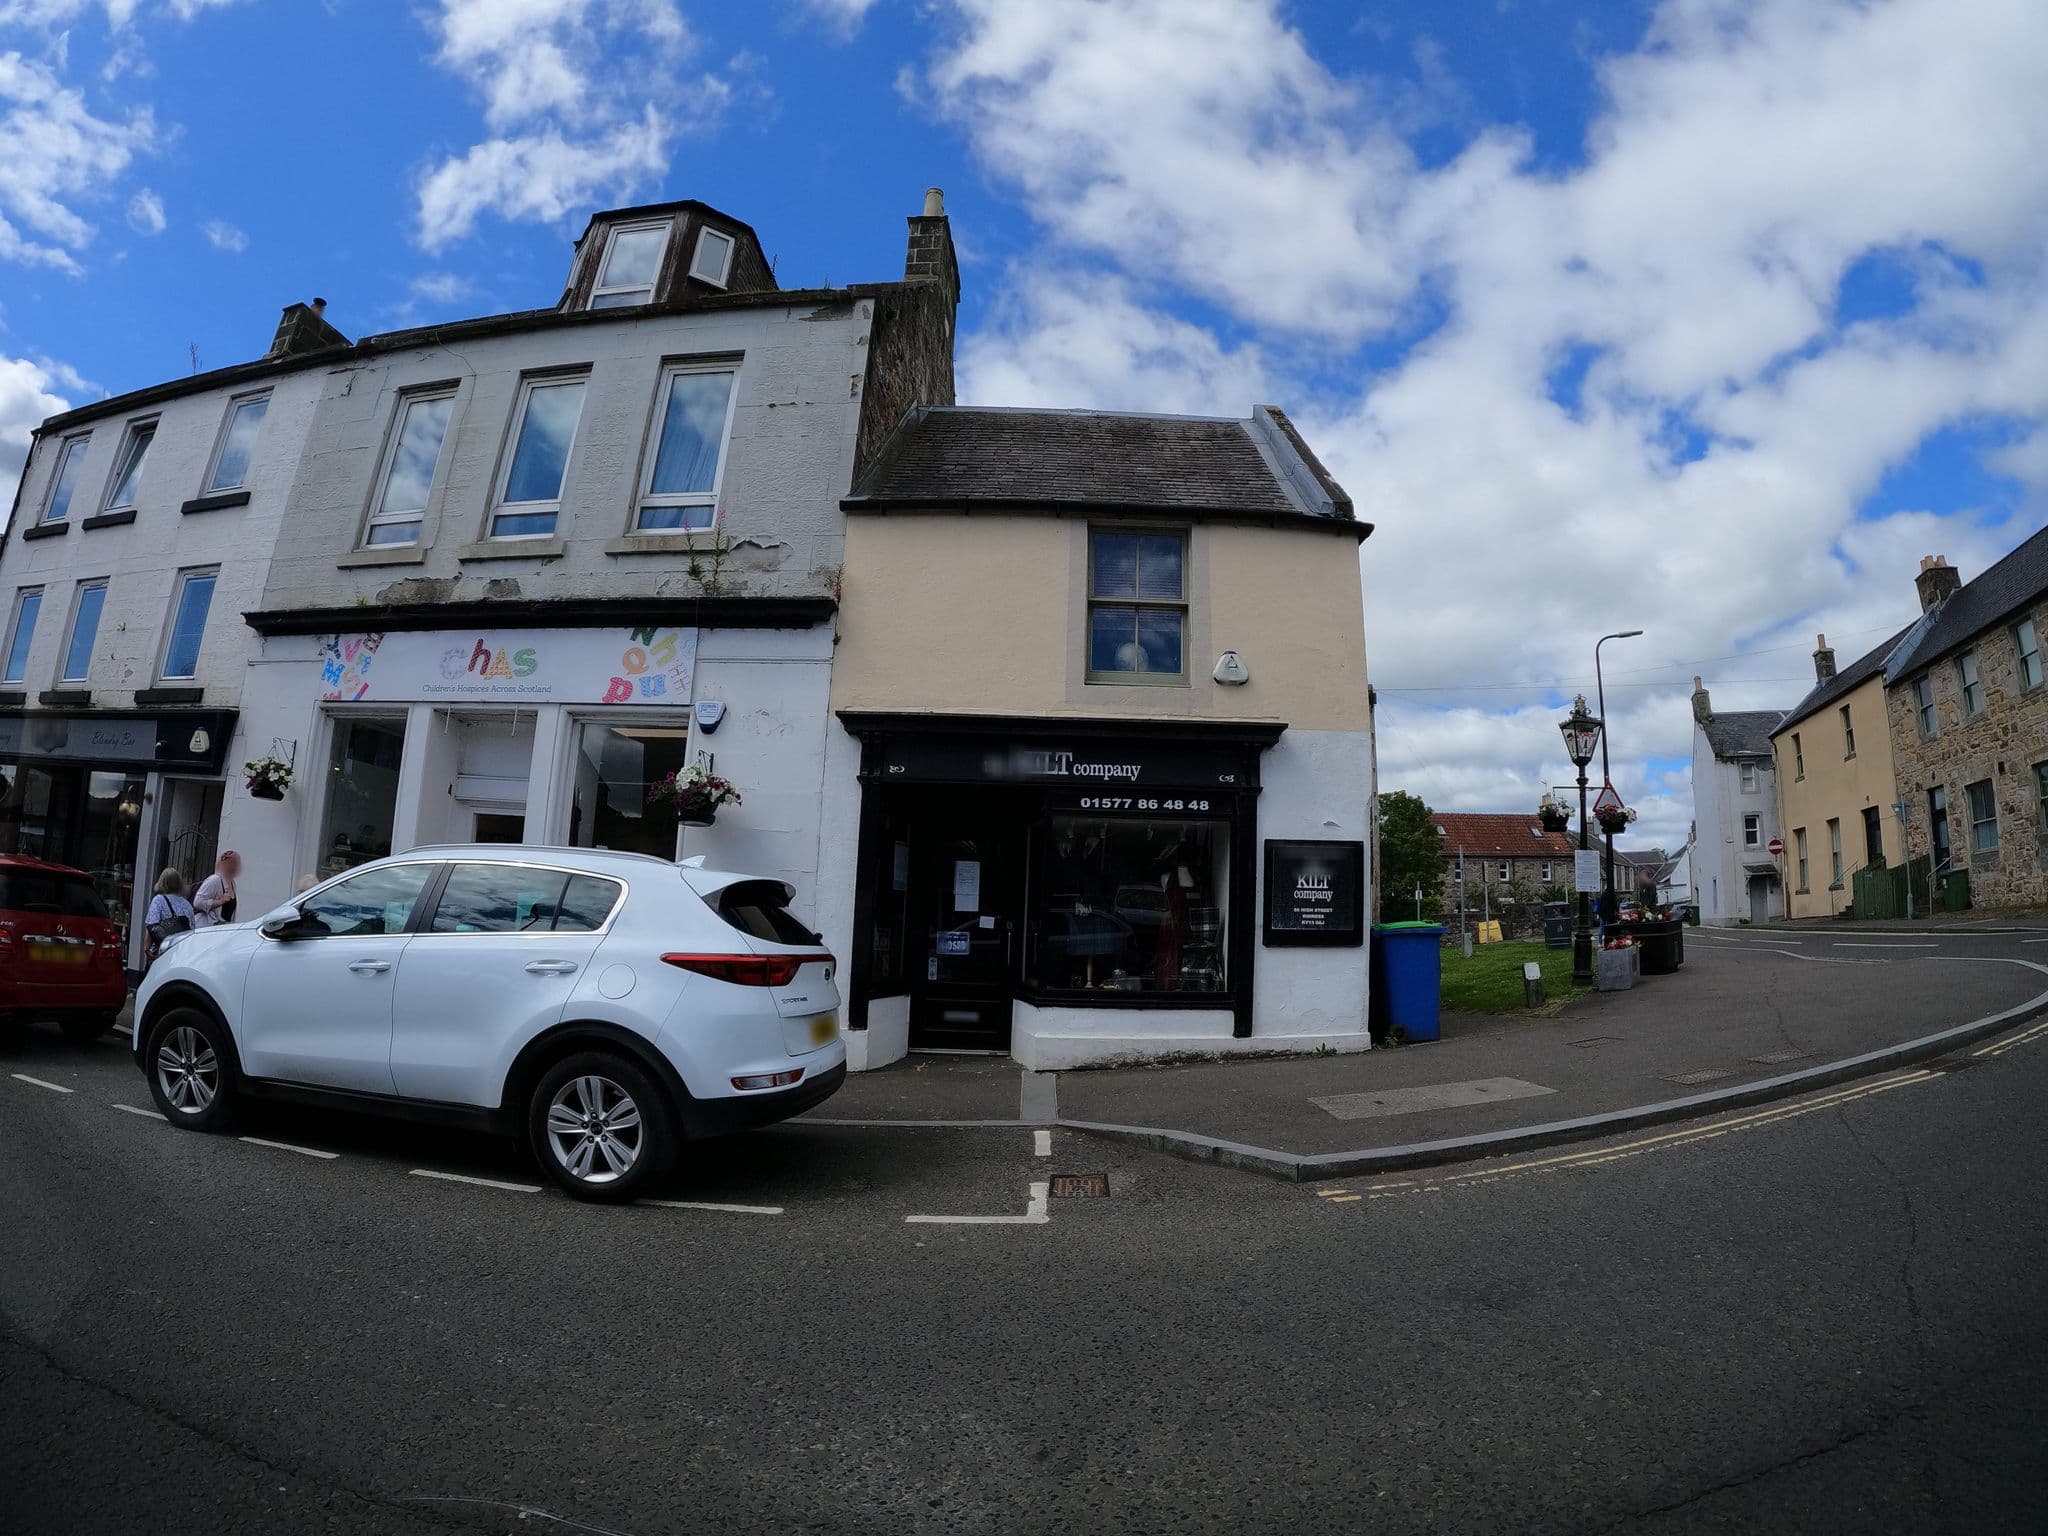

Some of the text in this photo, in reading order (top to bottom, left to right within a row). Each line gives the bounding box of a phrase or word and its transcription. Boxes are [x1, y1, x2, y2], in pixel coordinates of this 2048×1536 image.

[422, 684, 552, 695] Children's Hospices Across Scotland
[1073, 763, 1142, 780] company
[1080, 797, 1210, 811] 01577 86 48 48
[1296, 874, 1331, 888] KILT
[1294, 890, 1334, 902] company
